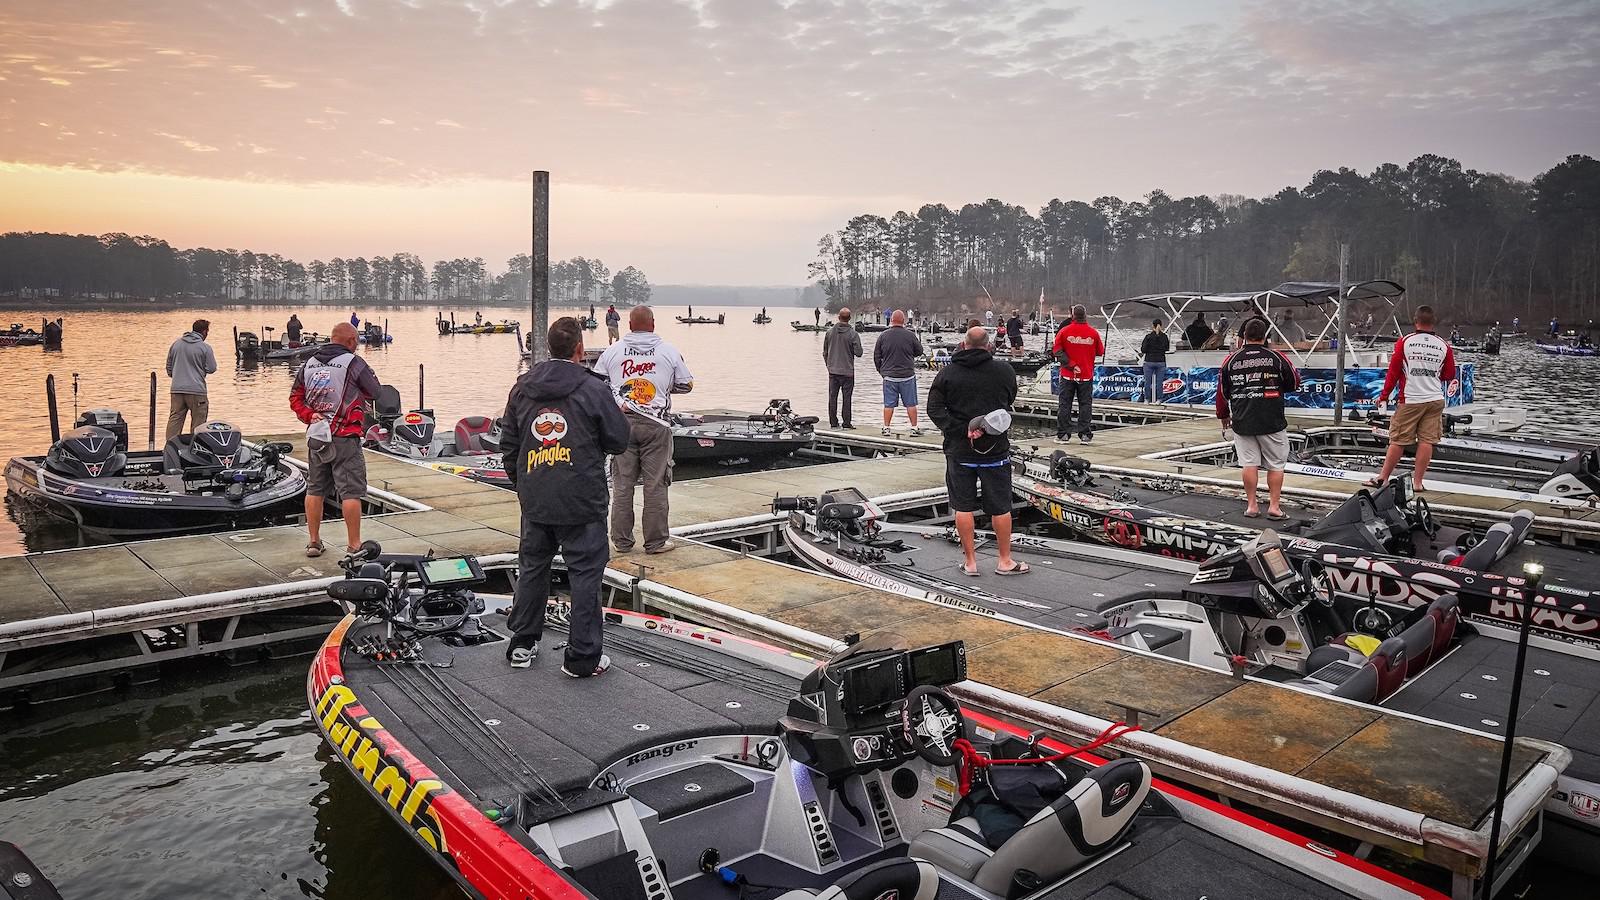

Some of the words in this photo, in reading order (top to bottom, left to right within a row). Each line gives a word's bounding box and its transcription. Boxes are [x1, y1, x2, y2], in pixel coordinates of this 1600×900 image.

[624, 348, 655, 356] LAWER
[1408, 343, 1443, 352] MITCHELL
[621, 358, 656, 379] Ranger
[527, 442, 571, 475] Pringles
[1301, 466, 1346, 478] LOWRANCE
[832, 559, 909, 594] SUNRISETACKLE.COM
[626, 740, 698, 767] Ranger
[1572, 795, 1599, 811] MLF
